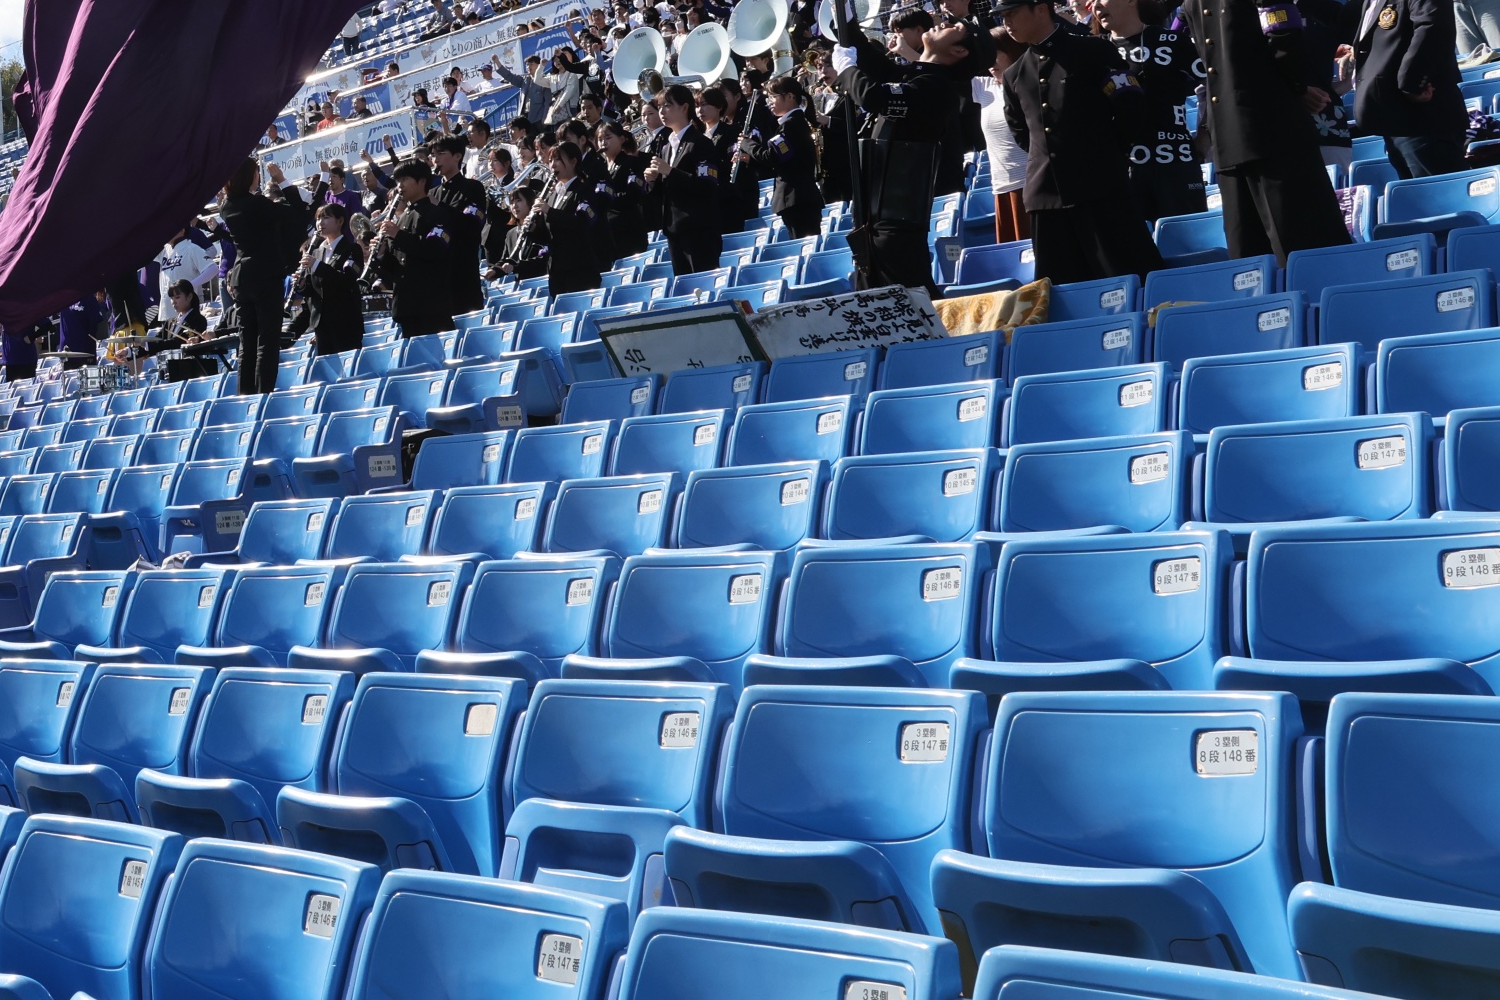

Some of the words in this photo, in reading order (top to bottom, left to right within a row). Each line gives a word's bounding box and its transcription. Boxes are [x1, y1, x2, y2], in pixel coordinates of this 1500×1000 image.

[1358, 448, 1406, 462] 10段147番
[1460, 553, 1486, 564] 3塁側
[1168, 564, 1187, 573] 3塁側
[1156, 571, 1199, 585] 9段147番
[674, 717, 690, 726] 3塁側
[663, 726, 697, 738] 8段146番
[916, 728, 937, 738] 3塁側
[903, 740, 947, 752] 8段147番
[1214, 736, 1240, 747] 3塁側
[1199, 748, 1256, 763] 8段148番
[553, 940, 572, 954] 3塁側
[541, 953, 580, 973] 7段147番
